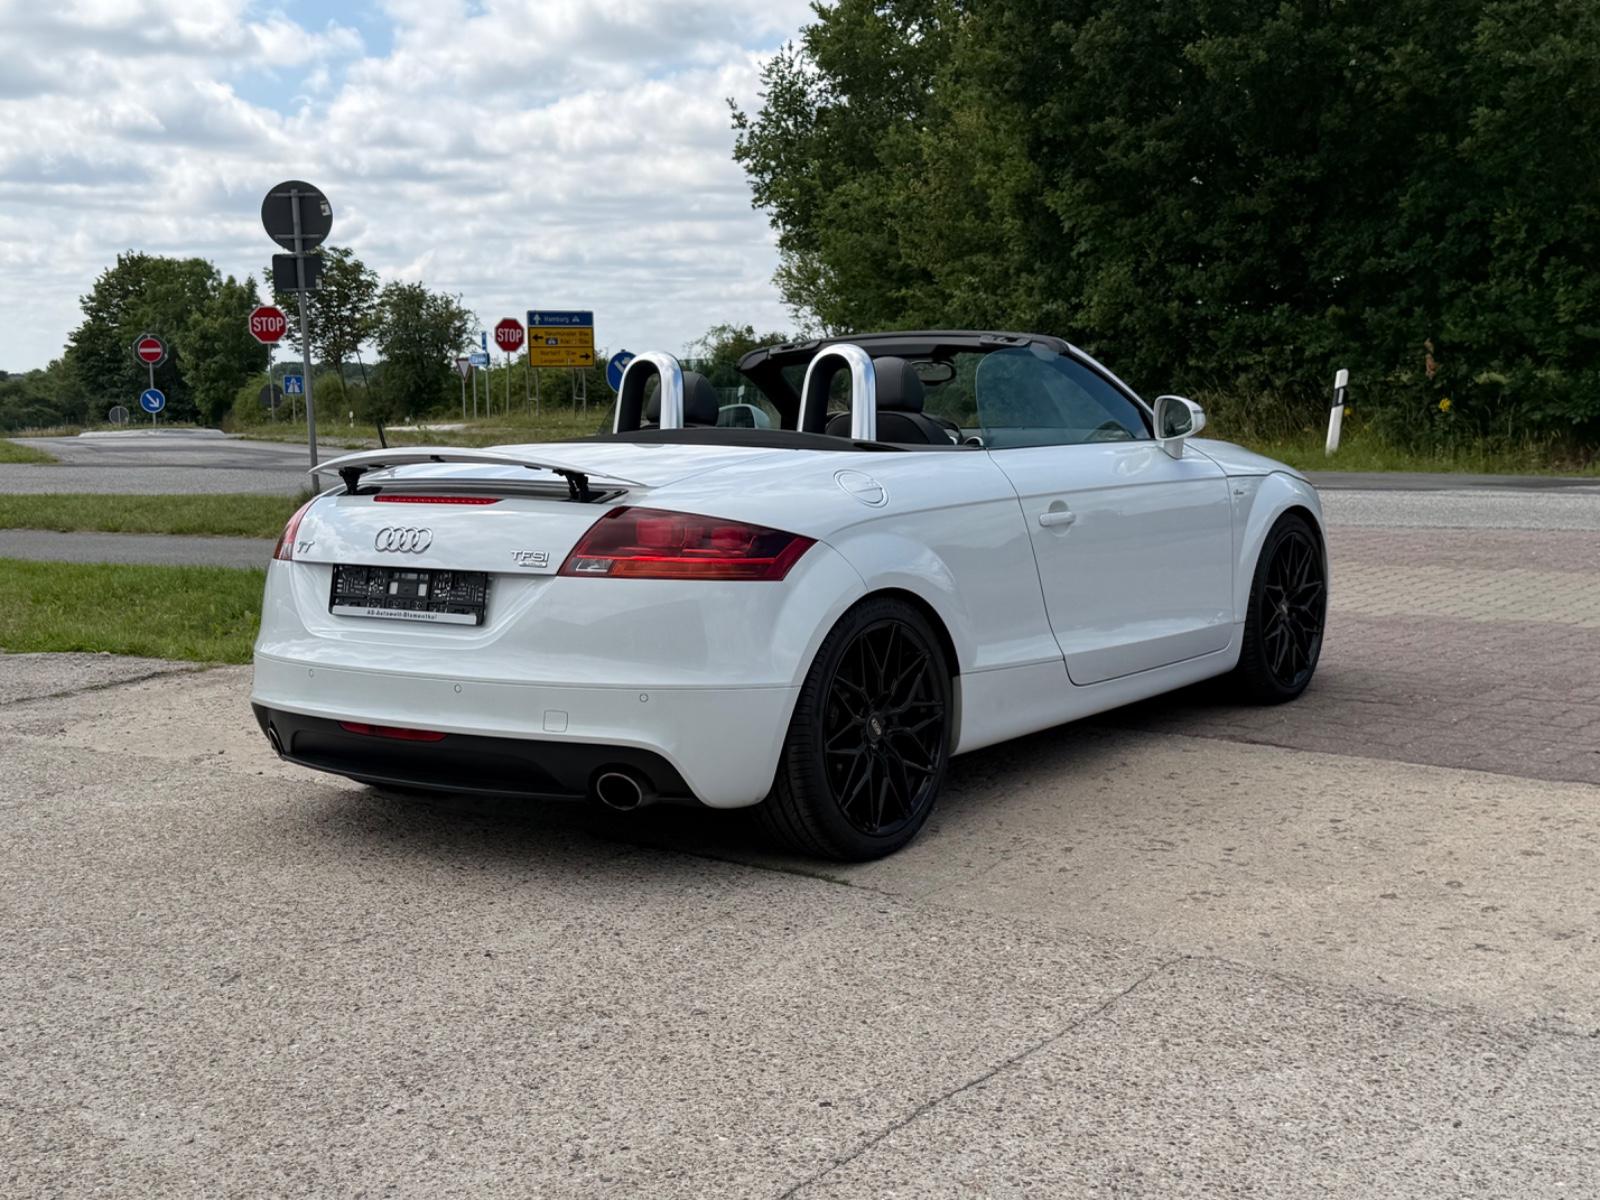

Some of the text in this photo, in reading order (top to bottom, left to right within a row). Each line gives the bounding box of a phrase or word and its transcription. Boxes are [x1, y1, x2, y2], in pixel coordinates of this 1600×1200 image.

[253, 316, 284, 332] STOP
[497, 328, 522, 344] STOP
[297, 540, 315, 554] TT
[510, 550, 550, 562] TFSI
